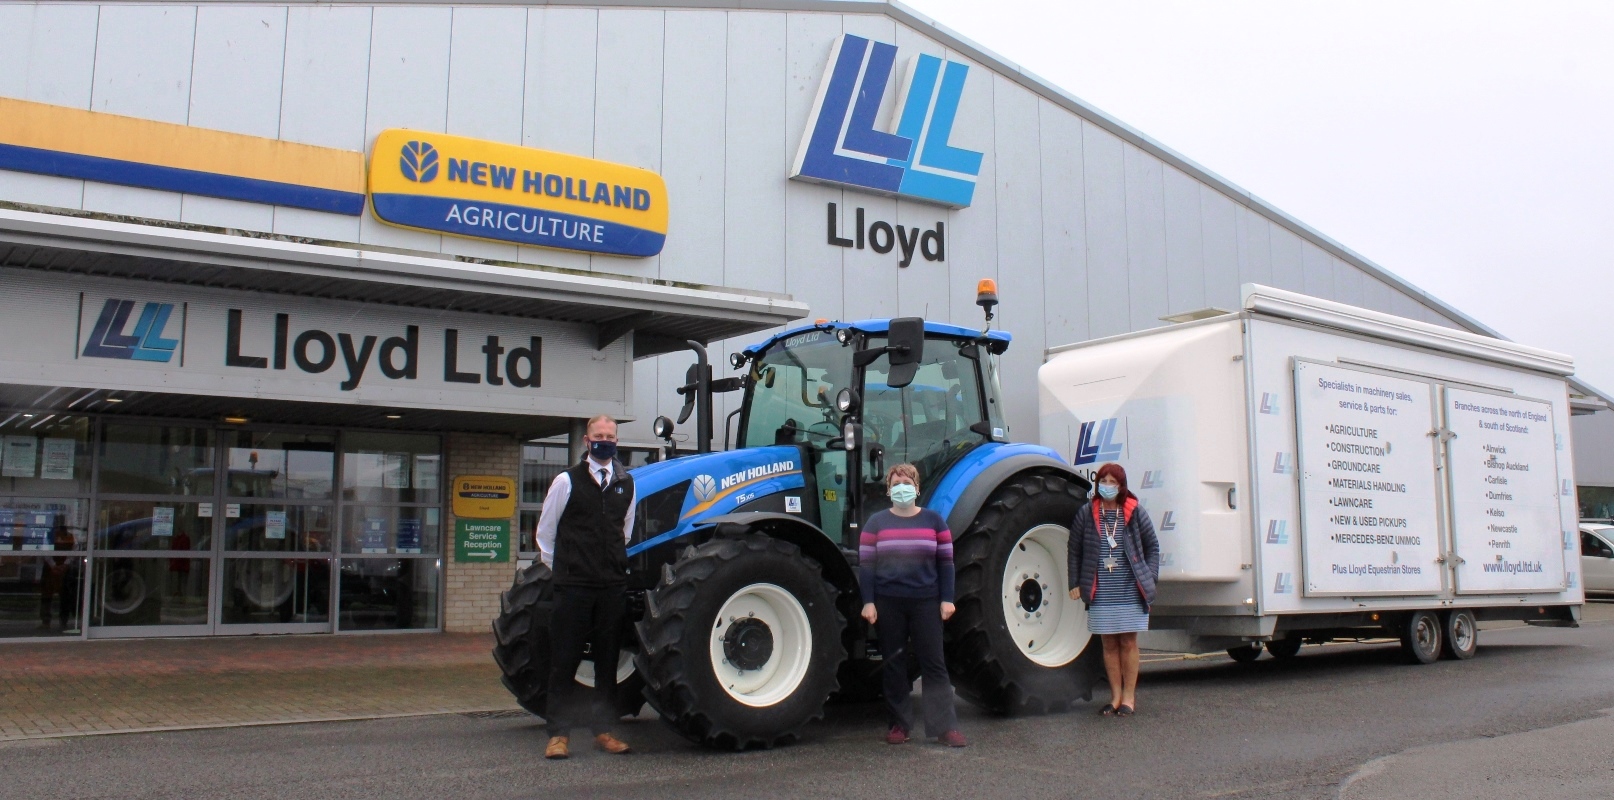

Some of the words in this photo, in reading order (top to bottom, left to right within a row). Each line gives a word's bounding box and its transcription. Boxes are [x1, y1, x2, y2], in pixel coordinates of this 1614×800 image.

[447, 157, 516, 190] NEW
[522, 170, 651, 211] HOLLAND
[446, 204, 604, 243] AGRICULTURE
[827, 202, 945, 268] Lloyd
[785, 335, 805, 348] Lloyd
[806, 332, 820, 343] Ltd
[226, 309, 419, 391] Lloyd
[444, 328, 542, 388] Ltd
[1318, 377, 1354, 393] Specialists
[1355, 384, 1362, 393] in
[1363, 386, 1395, 400] machinery
[1395, 392, 1413, 403] sales,
[1339, 400, 1362, 410] service
[1363, 402, 1369, 411] &
[1370, 404, 1386, 414] parts
[1387, 406, 1398, 416] for:
[1454, 401, 1480, 412] Branches
[1481, 406, 1499, 415] across
[1500, 407, 1508, 416] the
[1509, 409, 1522, 419] north
[1522, 411, 1528, 419] of
[1528, 411, 1547, 422] England
[1329, 424, 1378, 439] AGRICULTURE
[1479, 420, 1483, 429] &
[1484, 421, 1499, 430] south
[1500, 423, 1505, 431] of
[1505, 423, 1529, 434] Scotland:
[1330, 442, 1385, 457] CONSTRUCTION
[1486, 444, 1506, 454] Alnwick
[1332, 460, 1381, 473] GROUNDCARE
[1486, 460, 1505, 471] Bishop
[1505, 461, 1529, 471] Auckland
[721, 470, 747, 489] NEW
[747, 460, 794, 479] HOLLAND
[1488, 475, 1508, 485] Carlisle
[1332, 478, 1372, 490] MATERIALS
[1373, 481, 1406, 493] HANDLING
[1333, 497, 1373, 508] LAWNCARE
[1489, 491, 1513, 500] Dumfries
[1490, 508, 1505, 517] Kelso
[1334, 515, 1351, 525] NEW
[1353, 516, 1358, 526] &
[1359, 516, 1378, 526] USED
[1379, 517, 1407, 528] PICKUPS
[1491, 524, 1517, 533] Newcastle
[464, 541, 502, 549] Reception
[1335, 534, 1394, 545] MERCEDES-BENZ
[1395, 536, 1420, 545] UNIMOG
[1491, 540, 1511, 549] Penrith
[1332, 564, 1347, 574] Plus
[1349, 564, 1367, 576] Lloyd
[1368, 565, 1401, 576] Equestrian
[1401, 565, 1421, 575] Stores
[1483, 561, 1543, 575] www.lloyd.ltd.uk
